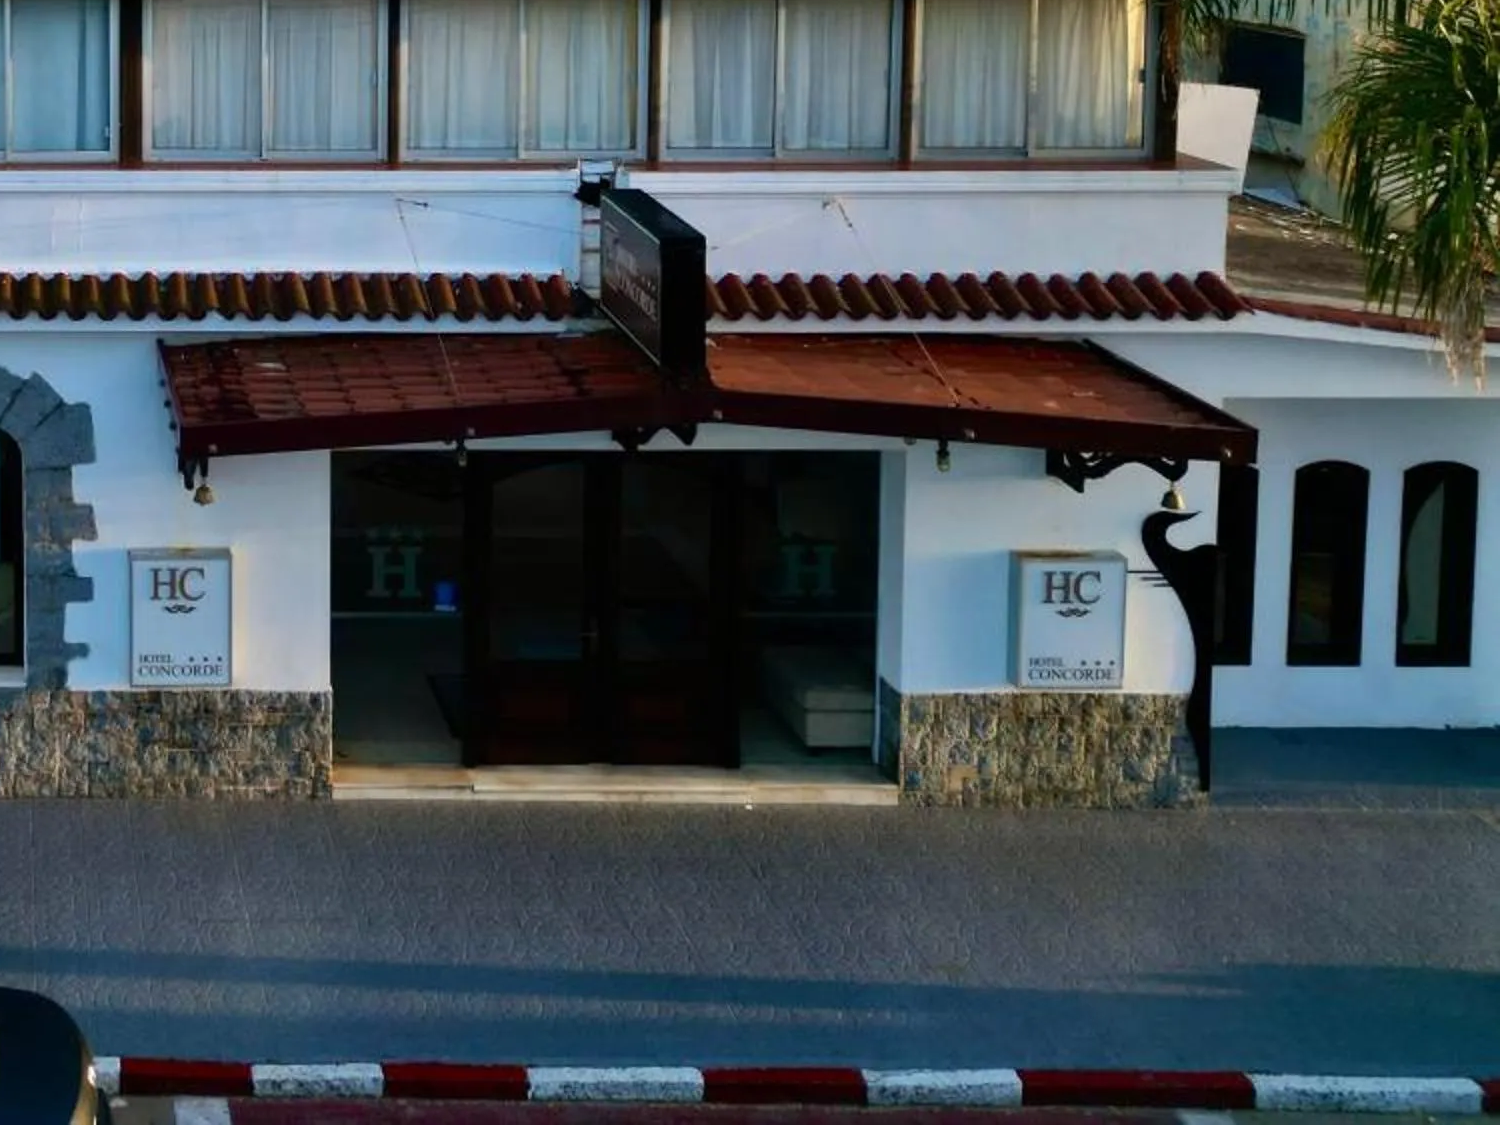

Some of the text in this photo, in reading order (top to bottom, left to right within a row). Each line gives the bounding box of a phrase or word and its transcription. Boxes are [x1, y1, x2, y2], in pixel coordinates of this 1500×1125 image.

[149, 567, 206, 601] HC
[1041, 571, 1102, 604] HC
[139, 654, 173, 664] HOTEL
[1029, 657, 1064, 667] HOTEL
[138, 664, 223, 677] CONCORDE
[1028, 668, 1114, 681] CONCORDE
